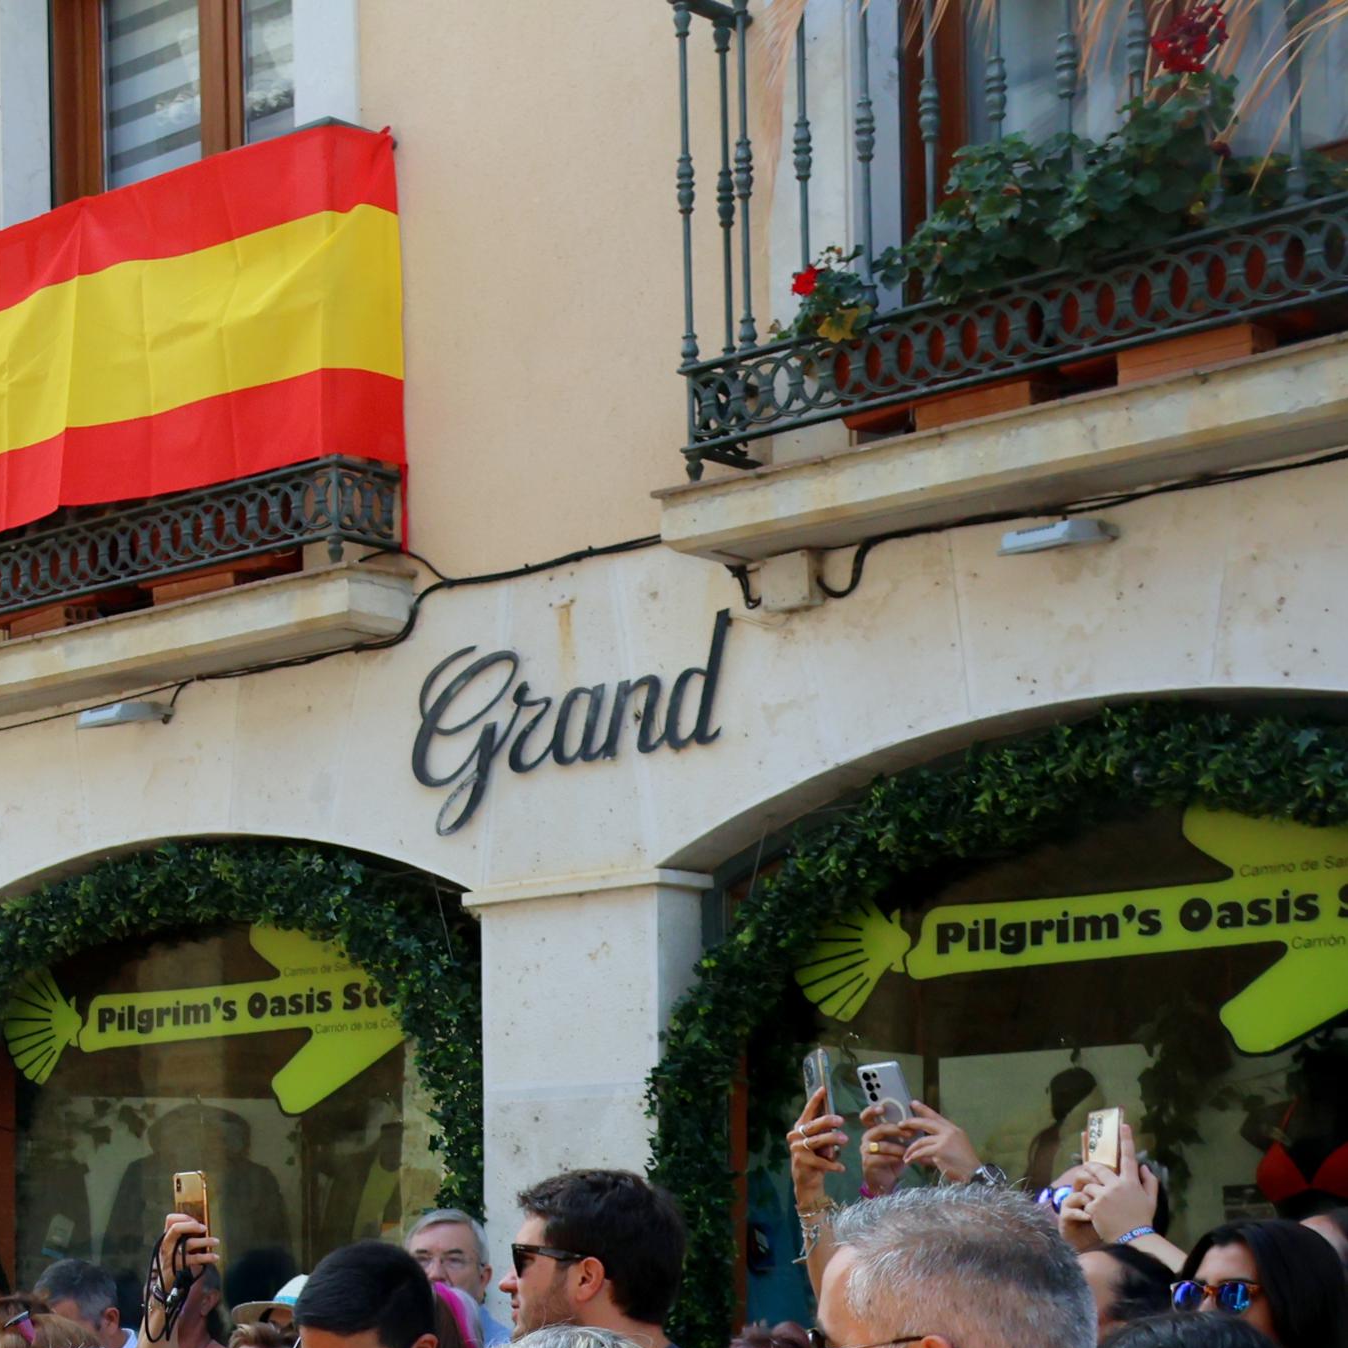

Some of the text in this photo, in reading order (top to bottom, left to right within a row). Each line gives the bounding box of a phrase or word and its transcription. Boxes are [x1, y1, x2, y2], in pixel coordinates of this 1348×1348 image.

[412, 608, 732, 837] Grand
[1300, 860, 1319, 872] de
[936, 904, 1163, 956] Pilgrim's
[1179, 889, 1321, 933] Oasis
[97, 998, 238, 1035] Pilgrim's
[247, 987, 333, 1020] Oasis
